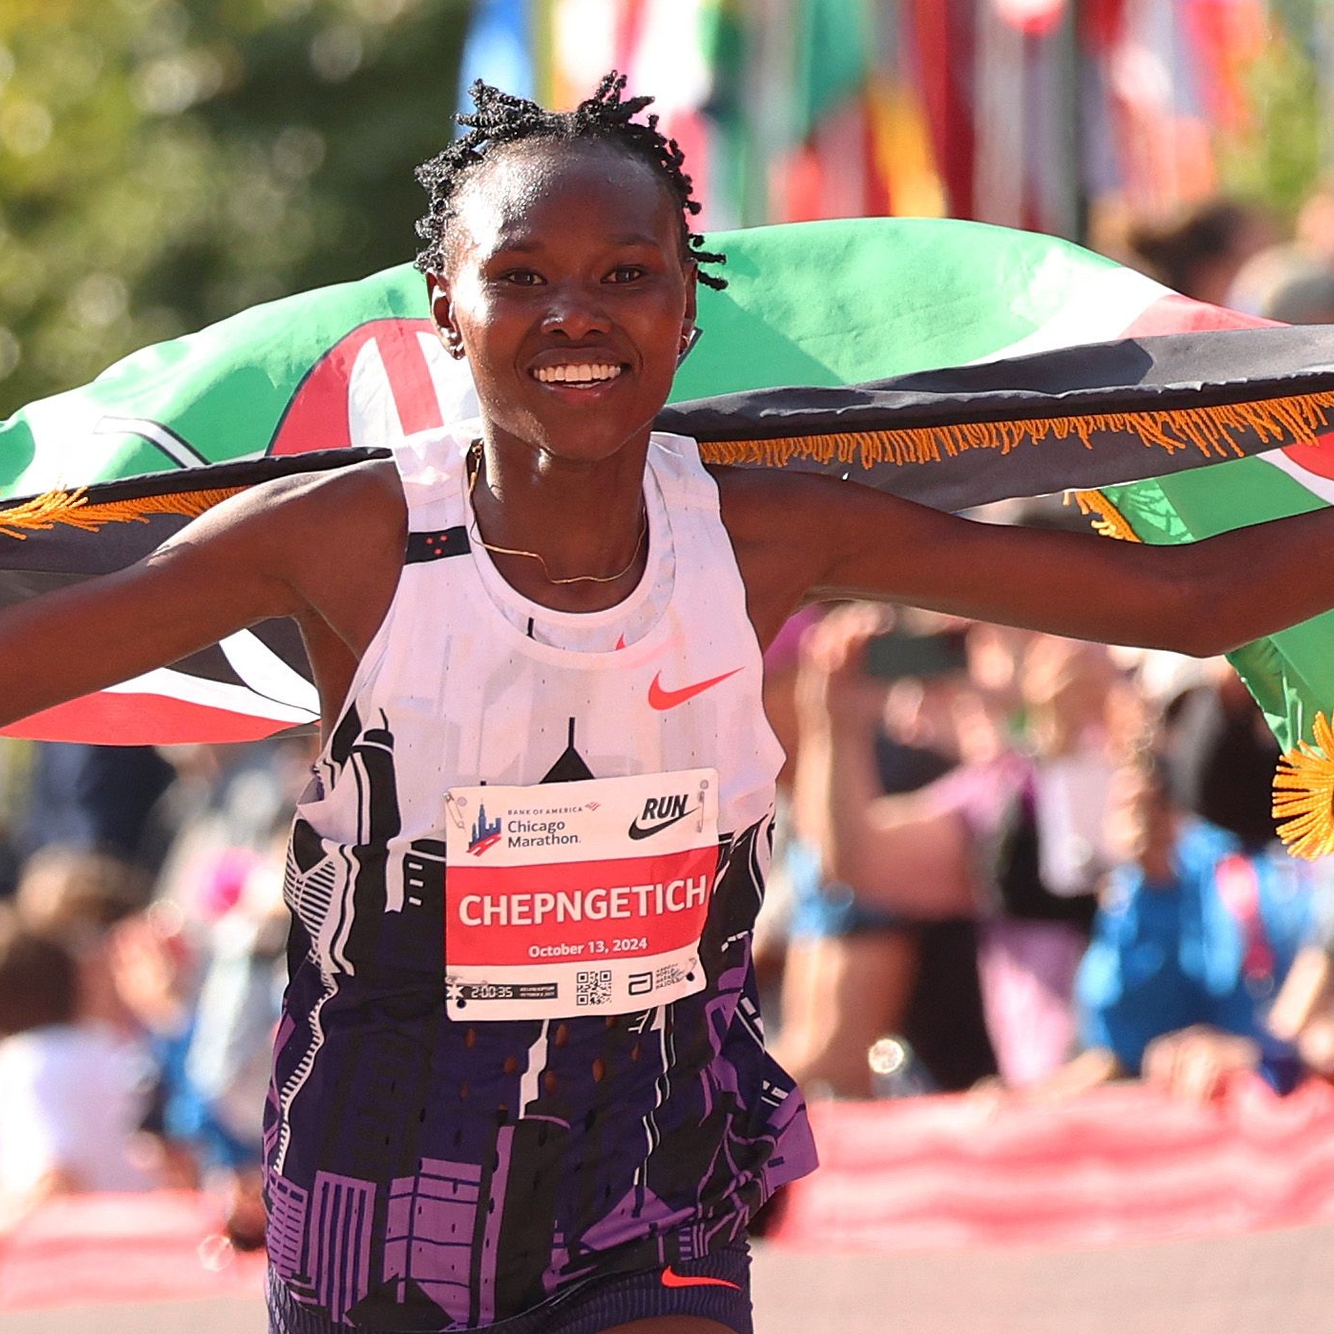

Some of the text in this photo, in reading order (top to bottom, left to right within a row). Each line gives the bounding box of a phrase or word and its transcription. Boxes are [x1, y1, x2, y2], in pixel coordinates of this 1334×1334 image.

[546, 806, 583, 814] AMERICA
[641, 794, 689, 820] RUN
[507, 820, 565, 834] Chicago
[458, 875, 707, 926] CHEPNGETICH
[528, 937, 648, 958] October 13, 2024
